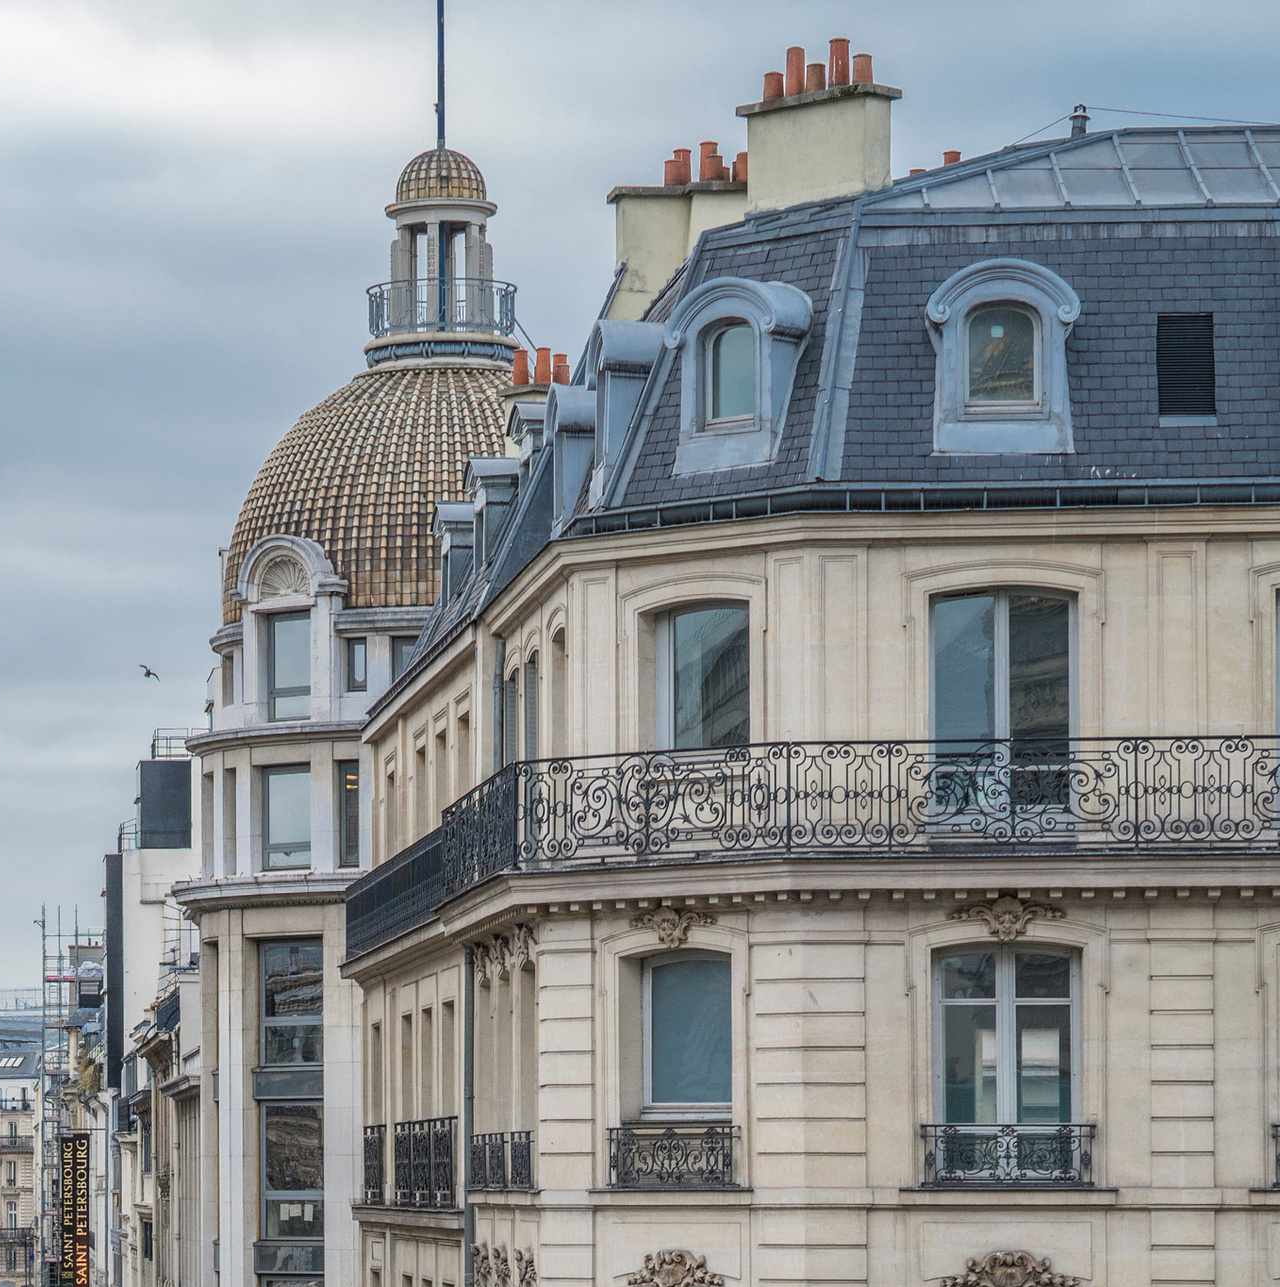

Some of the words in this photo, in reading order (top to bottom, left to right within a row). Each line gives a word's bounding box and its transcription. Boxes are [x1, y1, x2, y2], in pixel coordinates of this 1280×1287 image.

[64, 1142, 73, 1226] PETERSBOURG
[76, 1140, 88, 1236] PETERSBOURG
[64, 1232, 73, 1268] SAINT
[76, 1242, 87, 1284] SAINT
